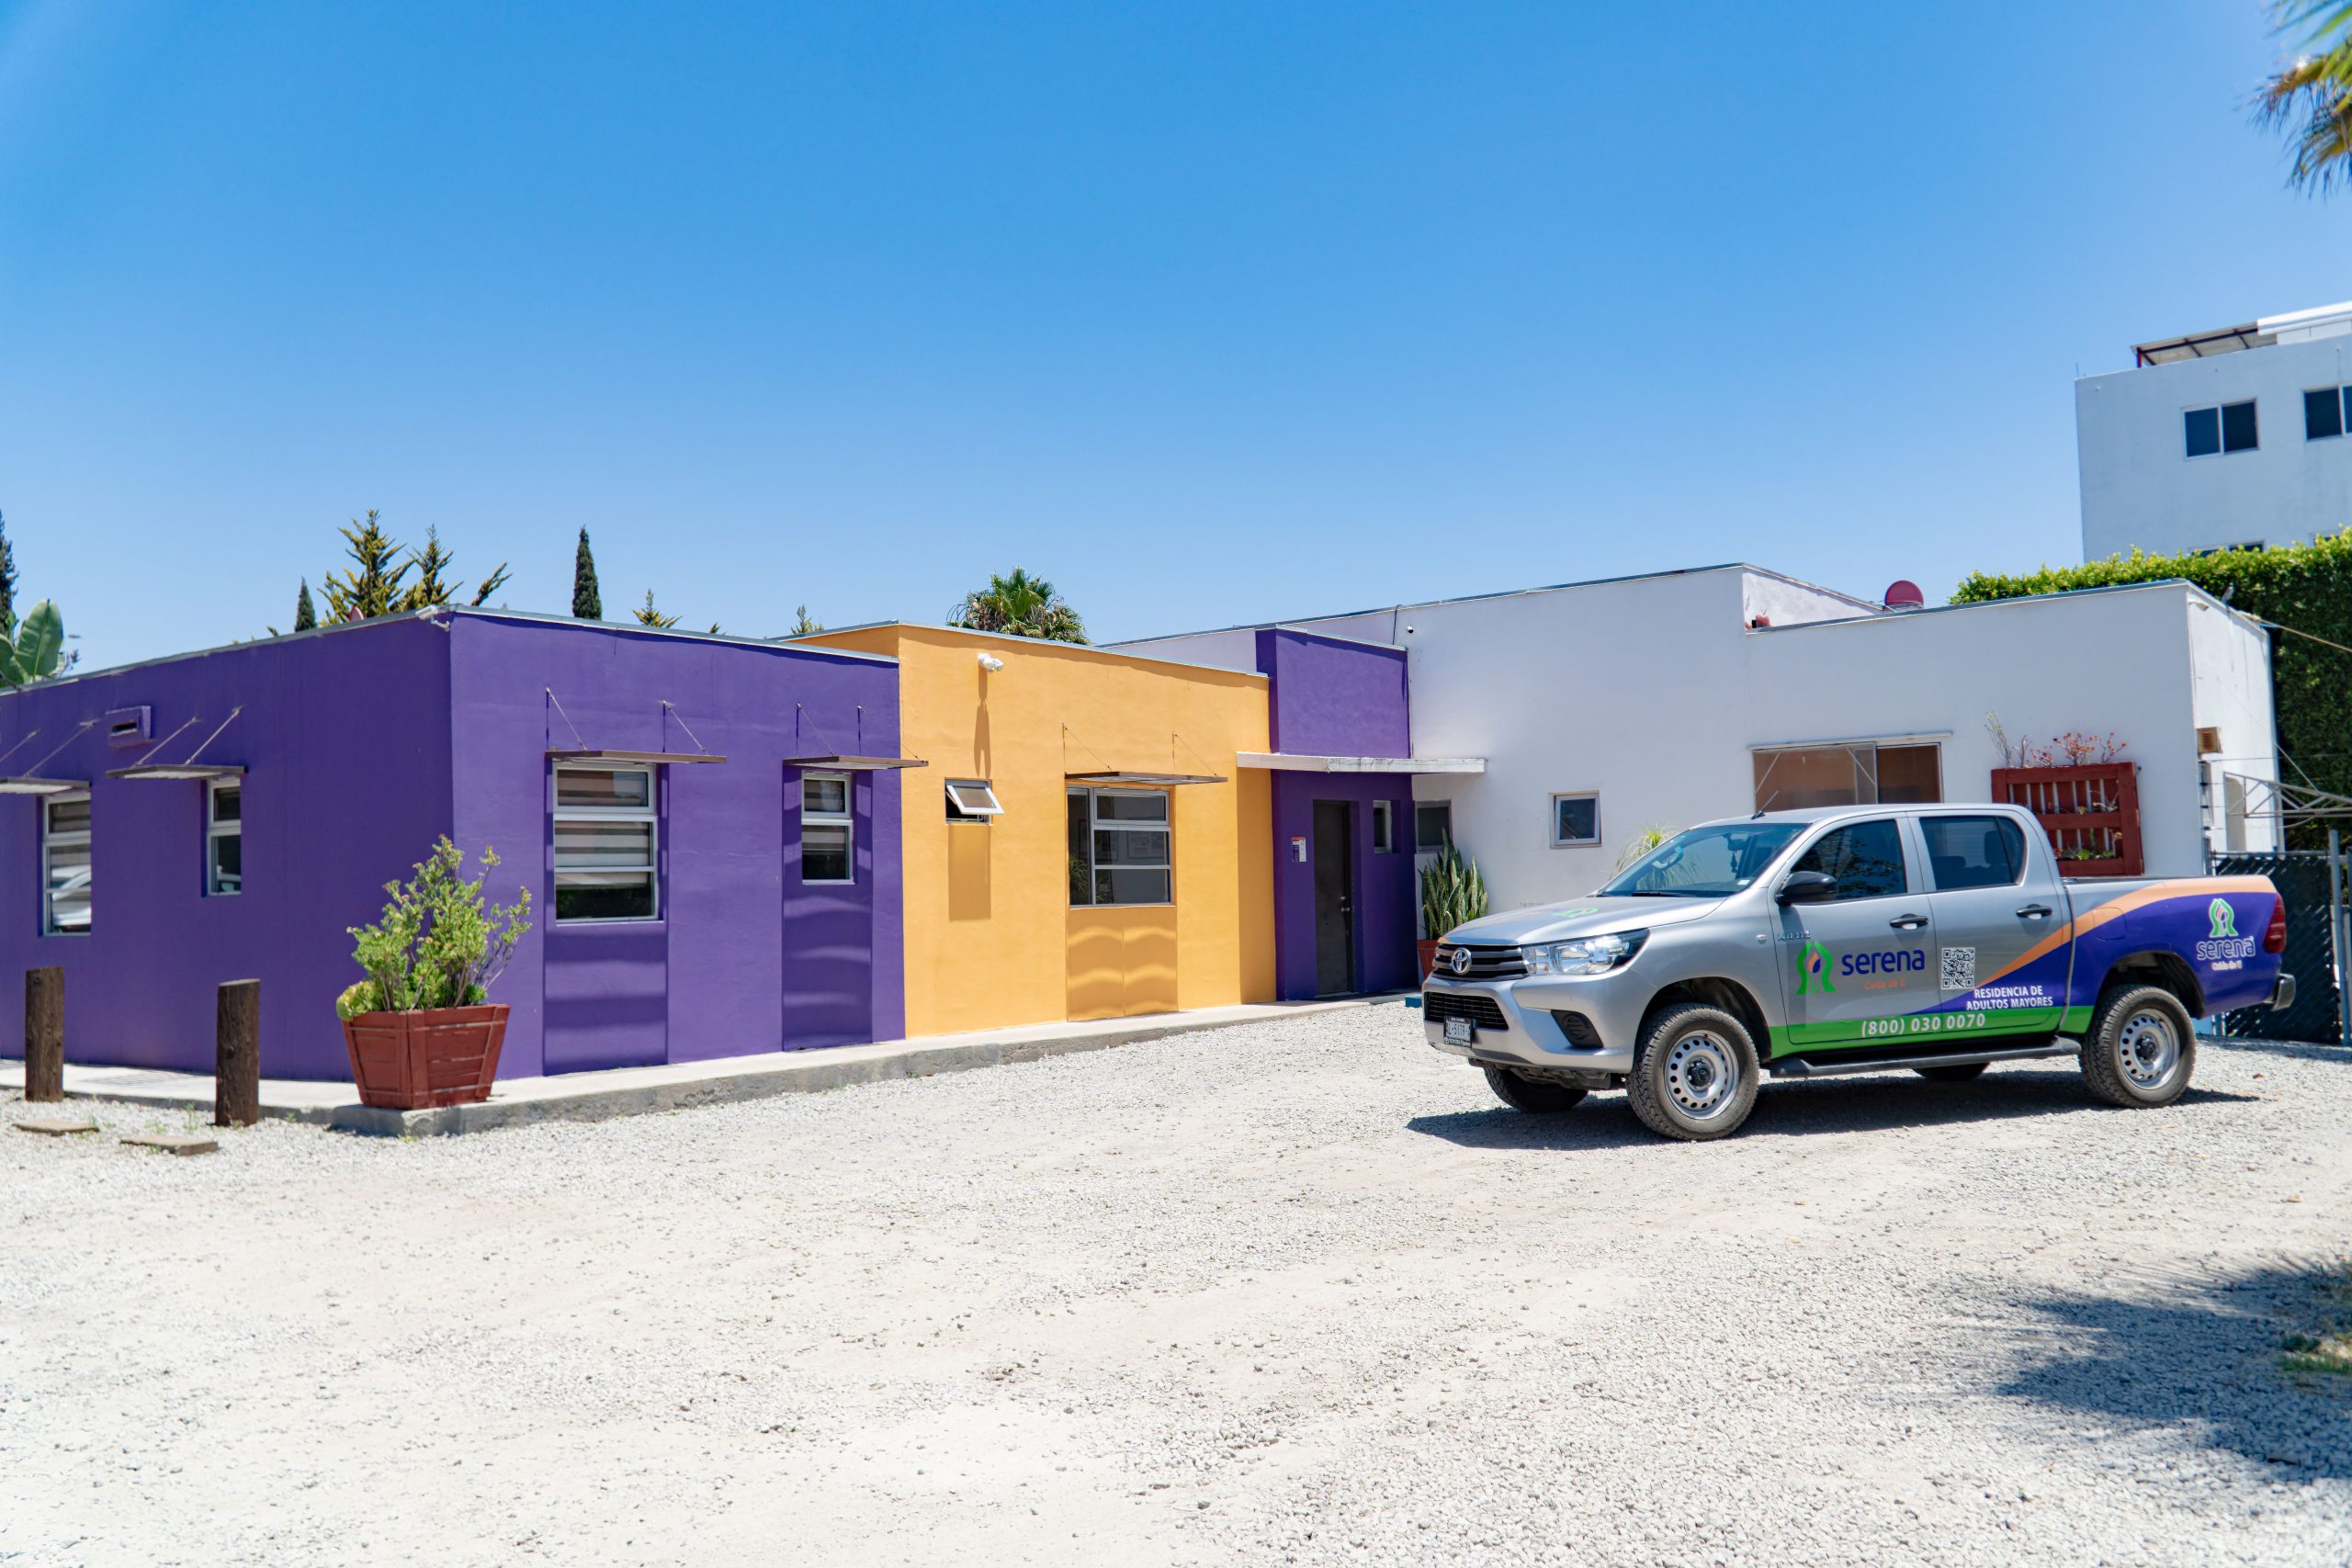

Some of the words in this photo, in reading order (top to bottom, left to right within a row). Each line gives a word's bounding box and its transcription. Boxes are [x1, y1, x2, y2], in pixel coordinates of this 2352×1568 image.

[2197, 938, 2256, 961] serena
[1841, 949, 1925, 976] serena
[1966, 999, 2008, 1010] ADULTOS
[2010, 997, 2053, 1008] MAYORES
[1974, 987, 2029, 998] RESIDENCIA
[2030, 986, 2043, 996] DE
[1861, 1018, 1905, 1037] (800)
[1911, 1016, 1941, 1032] 030
[1946, 1013, 1985, 1029] 0070
